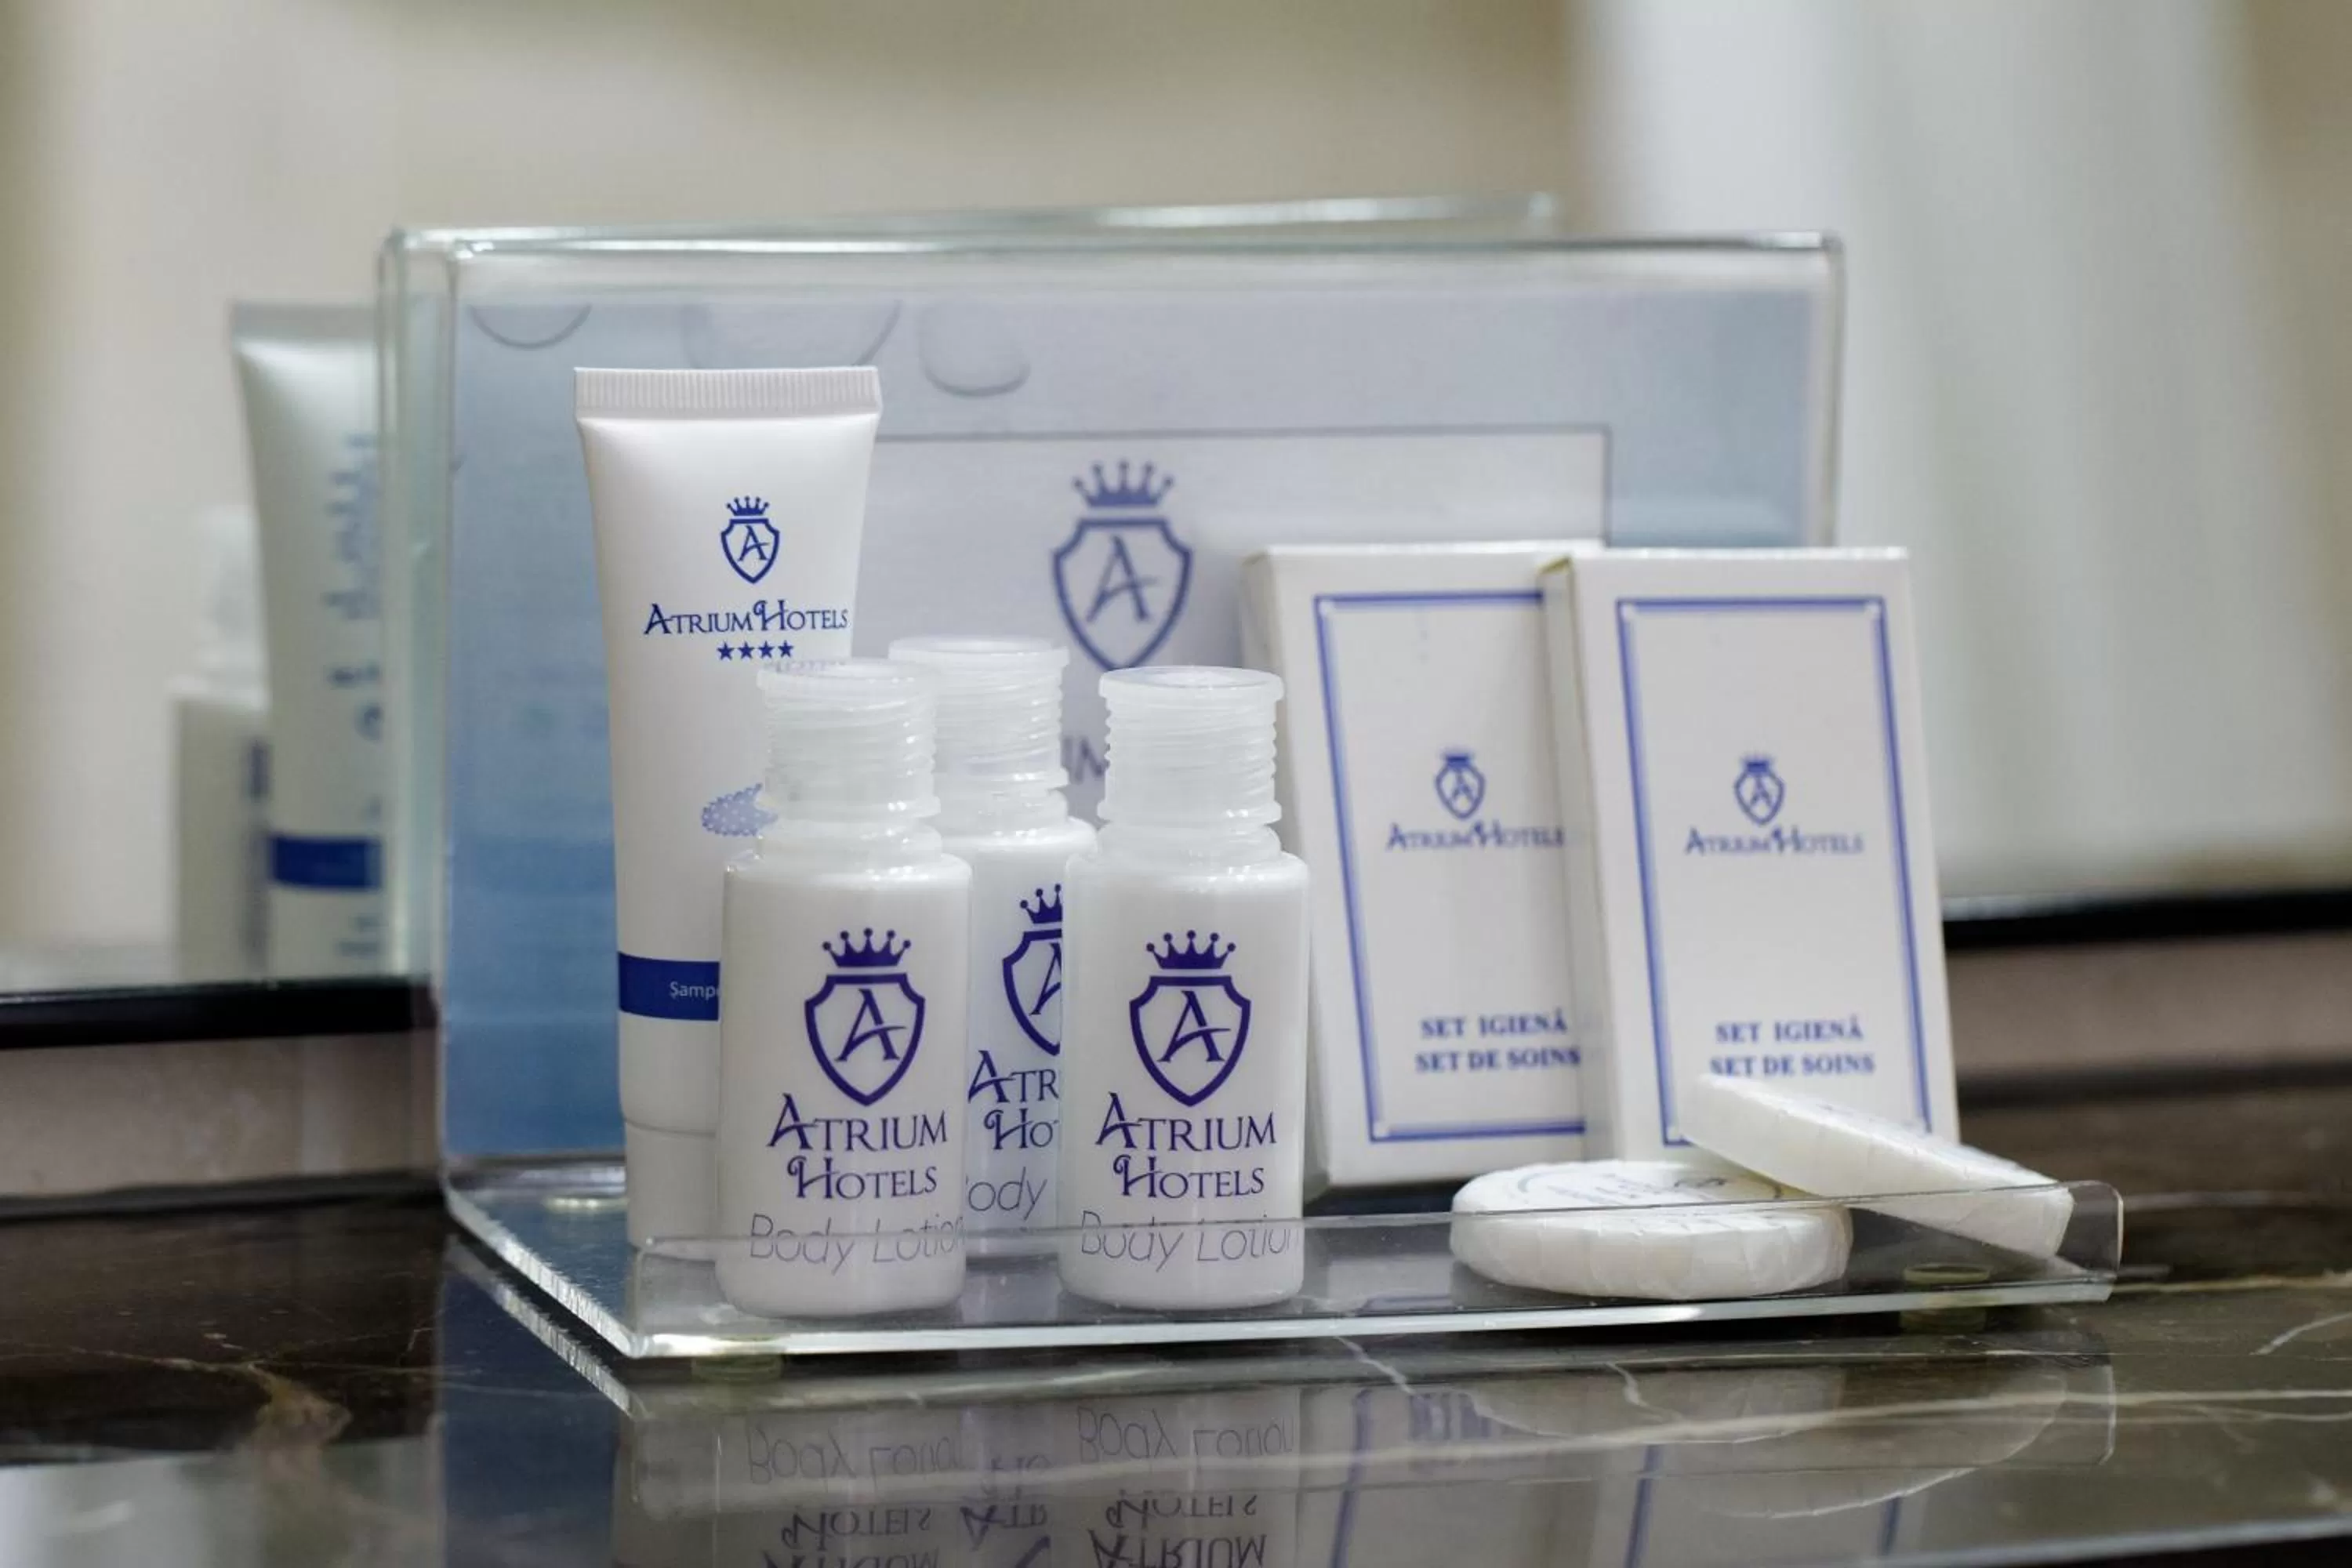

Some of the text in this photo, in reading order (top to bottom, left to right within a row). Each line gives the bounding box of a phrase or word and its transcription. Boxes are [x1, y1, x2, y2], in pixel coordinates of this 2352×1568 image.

[739, 525, 769, 561] A
[1086, 535, 1157, 622] A
[644, 599, 848, 634] ATRIUM HOTELS
[670, 981, 718, 1001] Şamp
[835, 989, 906, 1062] A
[1157, 990, 1232, 1063] A
[1421, 1016, 1465, 1038] SET
[1715, 1022, 1760, 1044] SET
[967, 1050, 1058, 1103] ATR
[1416, 1046, 1581, 1073] SET DE SOINS
[1710, 1052, 1876, 1076] SET DE SOINS
[766, 1093, 948, 1151] ATRIUM
[1094, 1091, 1277, 1151] ATRIUM
[787, 1156, 938, 1200] HOTELS
[965, 1167, 1047, 1220] ody
[1113, 1154, 1264, 1199] HOTELS
[750, 1213, 855, 1276] Body
[1081, 1210, 1184, 1272] Body
